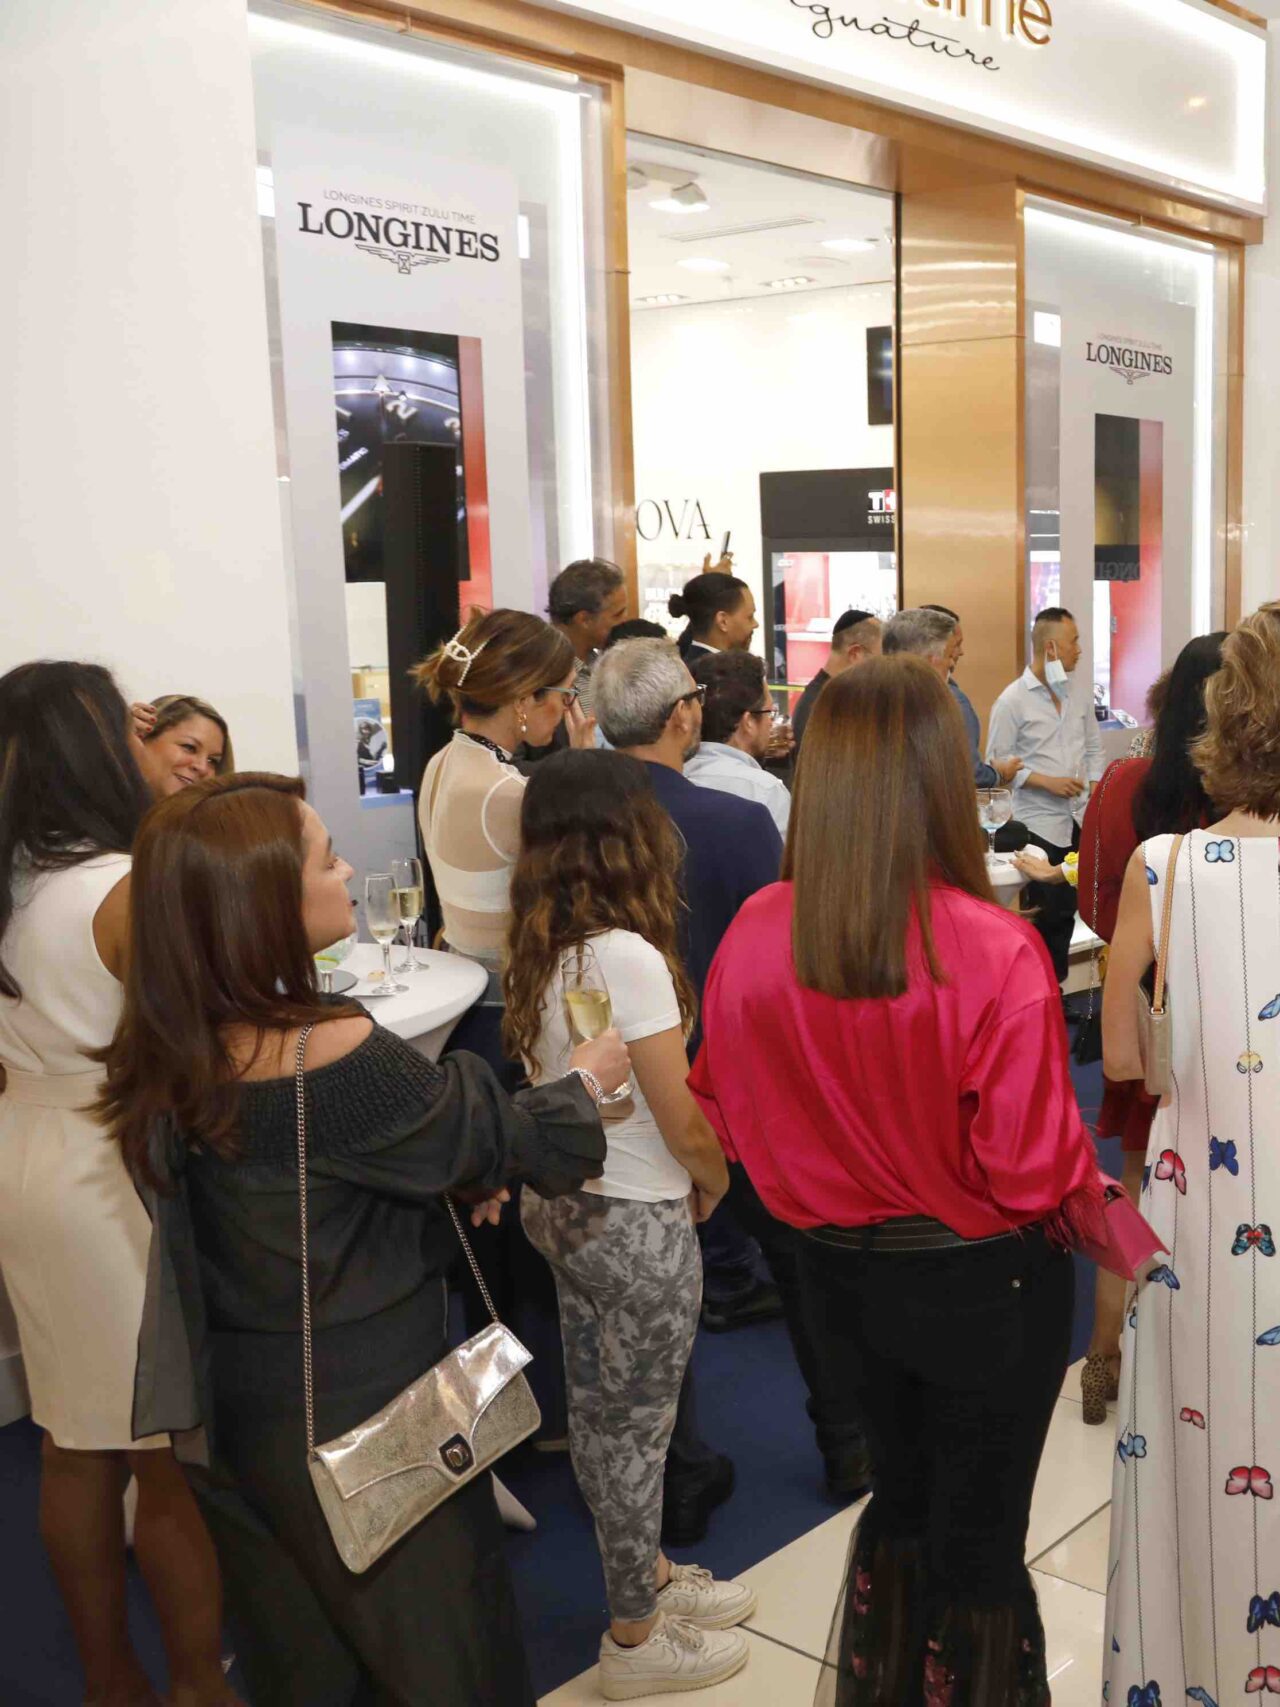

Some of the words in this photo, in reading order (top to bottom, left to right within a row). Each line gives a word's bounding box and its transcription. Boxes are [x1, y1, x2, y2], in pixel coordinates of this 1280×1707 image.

[323, 190, 383, 208] LONGINES
[385, 199, 419, 216] SPIRIT
[421, 206, 450, 221] ZULU
[452, 211, 476, 225] TIME
[297, 202, 500, 262] LONGINES
[1086, 342, 1172, 375] LONGINES
